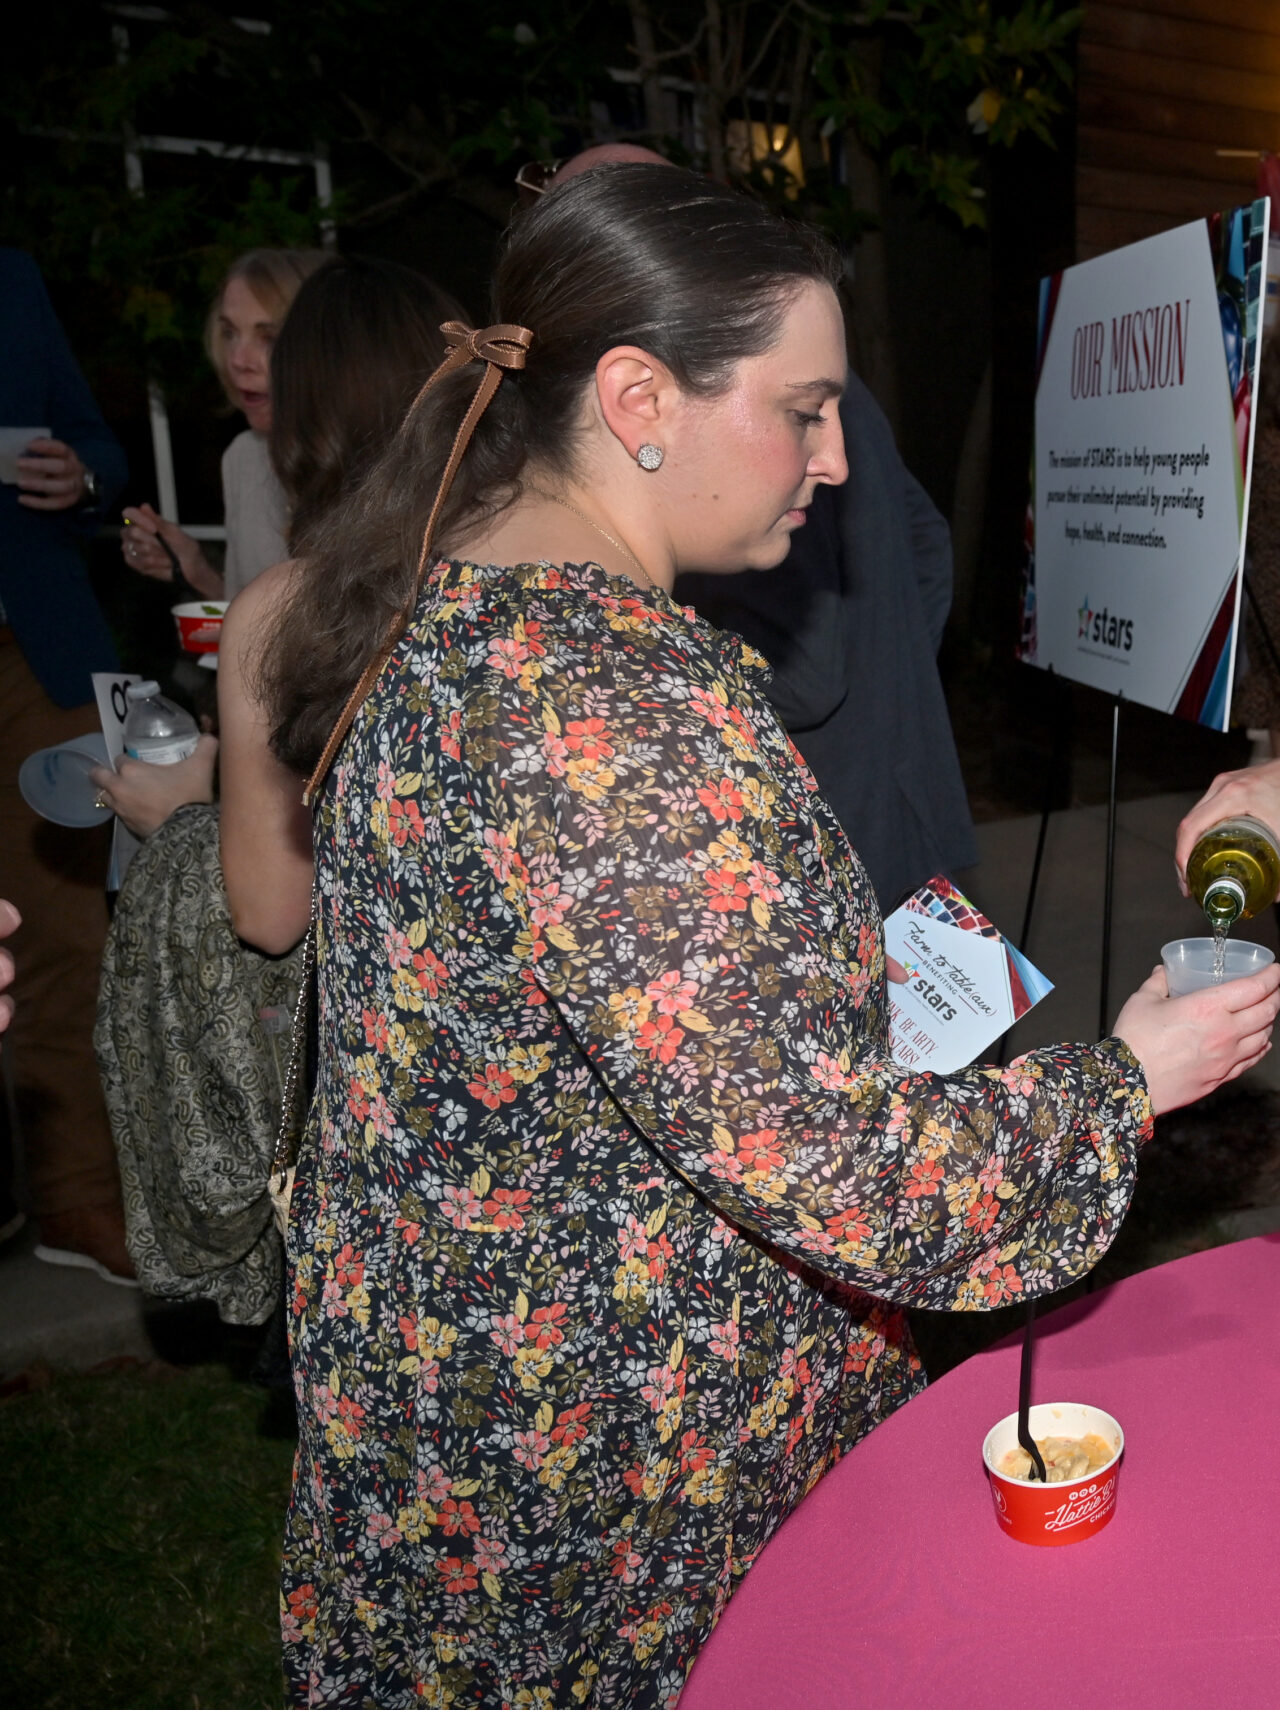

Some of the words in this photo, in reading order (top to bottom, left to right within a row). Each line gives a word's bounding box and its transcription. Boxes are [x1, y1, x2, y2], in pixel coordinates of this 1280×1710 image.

[1071, 320, 1104, 400] OUR
[1108, 299, 1190, 395] MISSION
[1049, 450, 1059, 468] The
[1083, 448, 1091, 467] of
[1091, 447, 1115, 467] STARS
[1117, 448, 1123, 467] is
[1124, 451, 1132, 467] to
[1133, 445, 1150, 475] help
[1151, 453, 1178, 475] young
[1179, 443, 1210, 475] people
[1082, 485, 1114, 505] unlimited
[1115, 485, 1149, 514] potential
[1151, 486, 1160, 516] by
[1161, 486, 1204, 519] providing
[1107, 523, 1121, 543] and
[1122, 527, 1167, 548] connection.
[1093, 607, 1134, 652] stars
[904, 921, 932, 956] Farm
[932, 954, 950, 968] to
[922, 960, 957, 995] BENEFITING
[913, 979, 957, 1021] stars
[899, 1017, 917, 1035] BE
[910, 1030, 939, 1059] ARTY.
